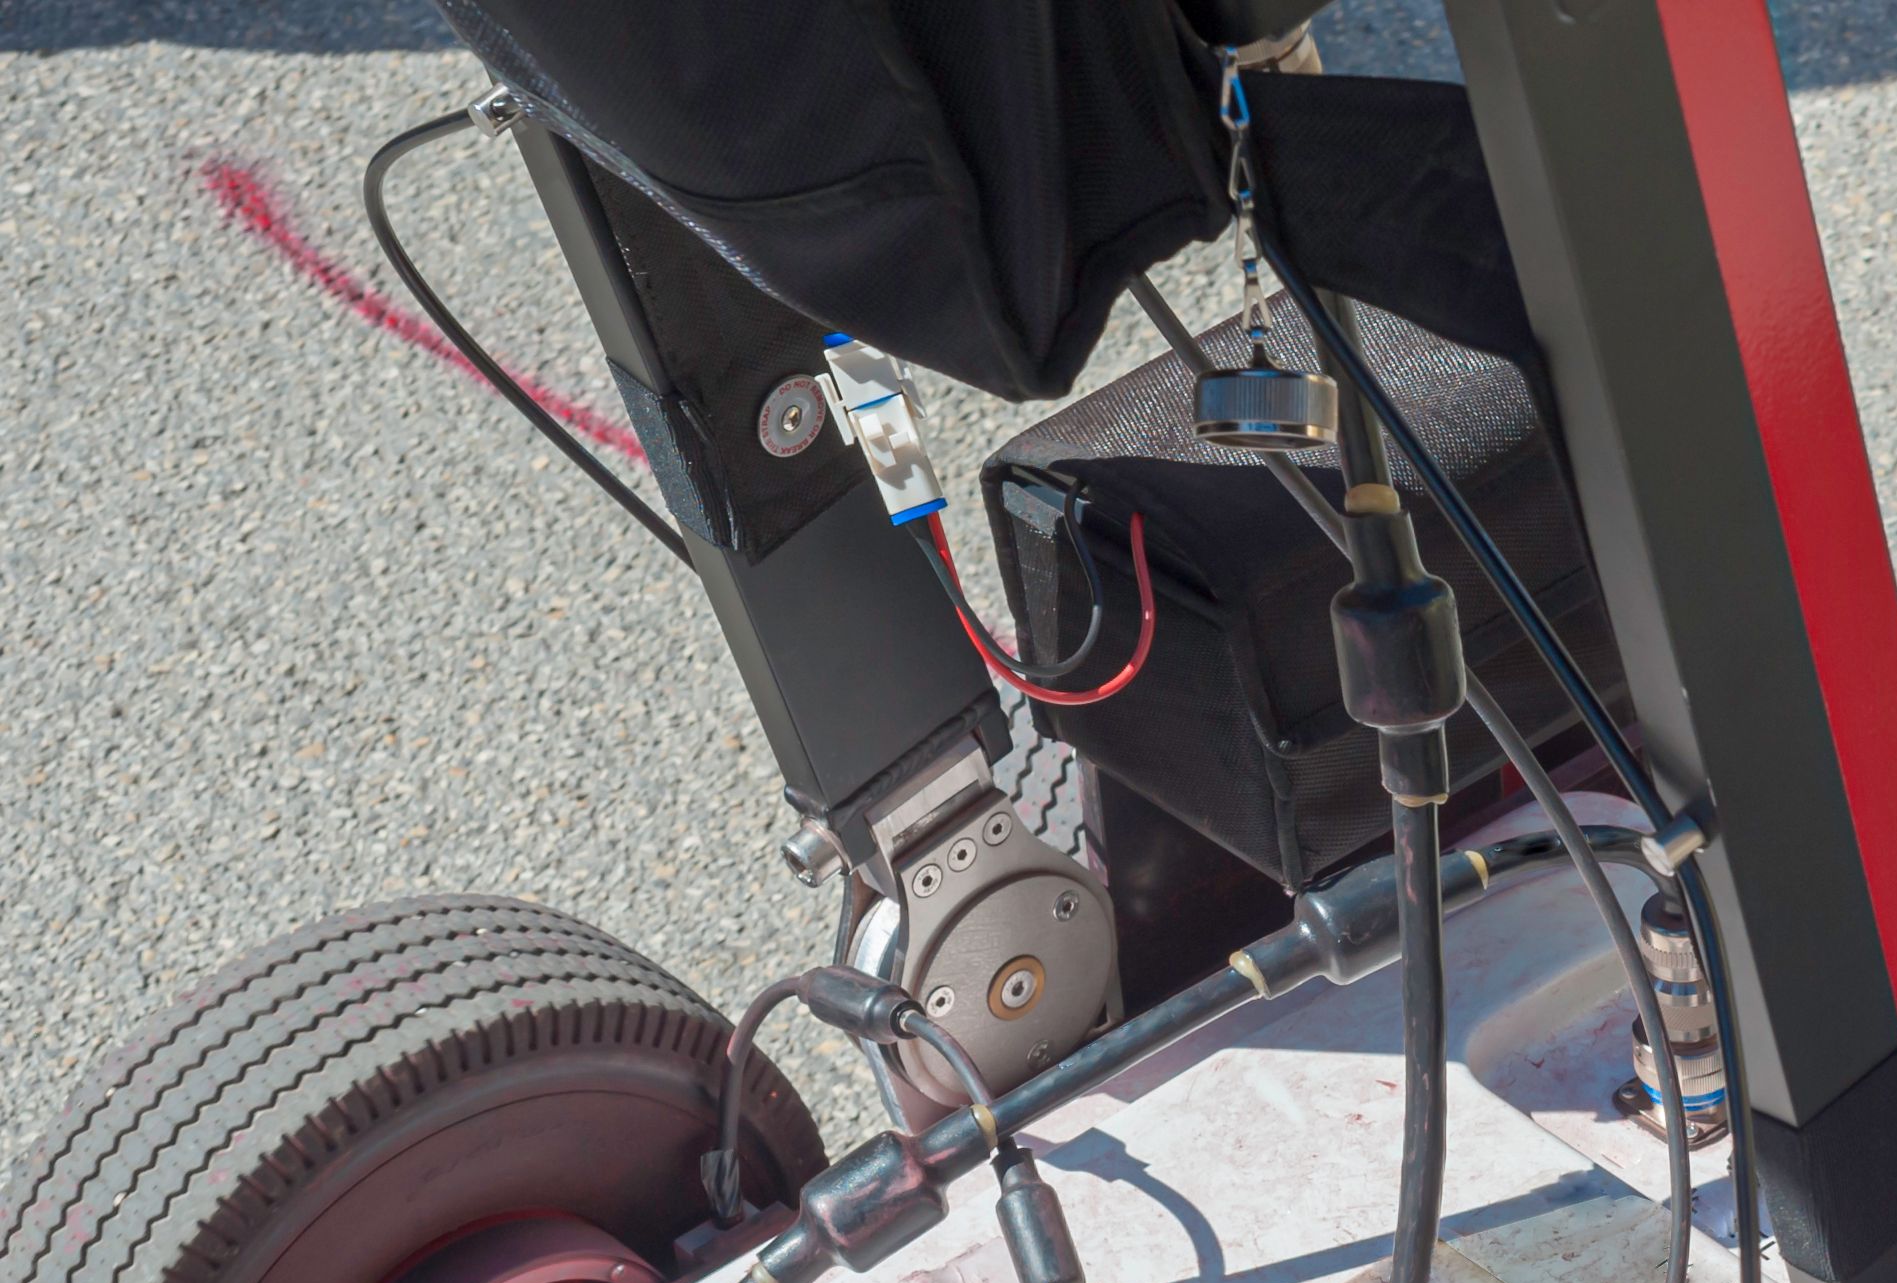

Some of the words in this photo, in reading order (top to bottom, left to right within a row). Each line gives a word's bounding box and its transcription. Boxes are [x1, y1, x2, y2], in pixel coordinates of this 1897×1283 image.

[779, 383, 791, 396] DO
[793, 380, 810, 389] NOT
[761, 405, 770, 438] STRAP
[809, 424, 819, 438] OR
[781, 438, 809, 455] BREAK
